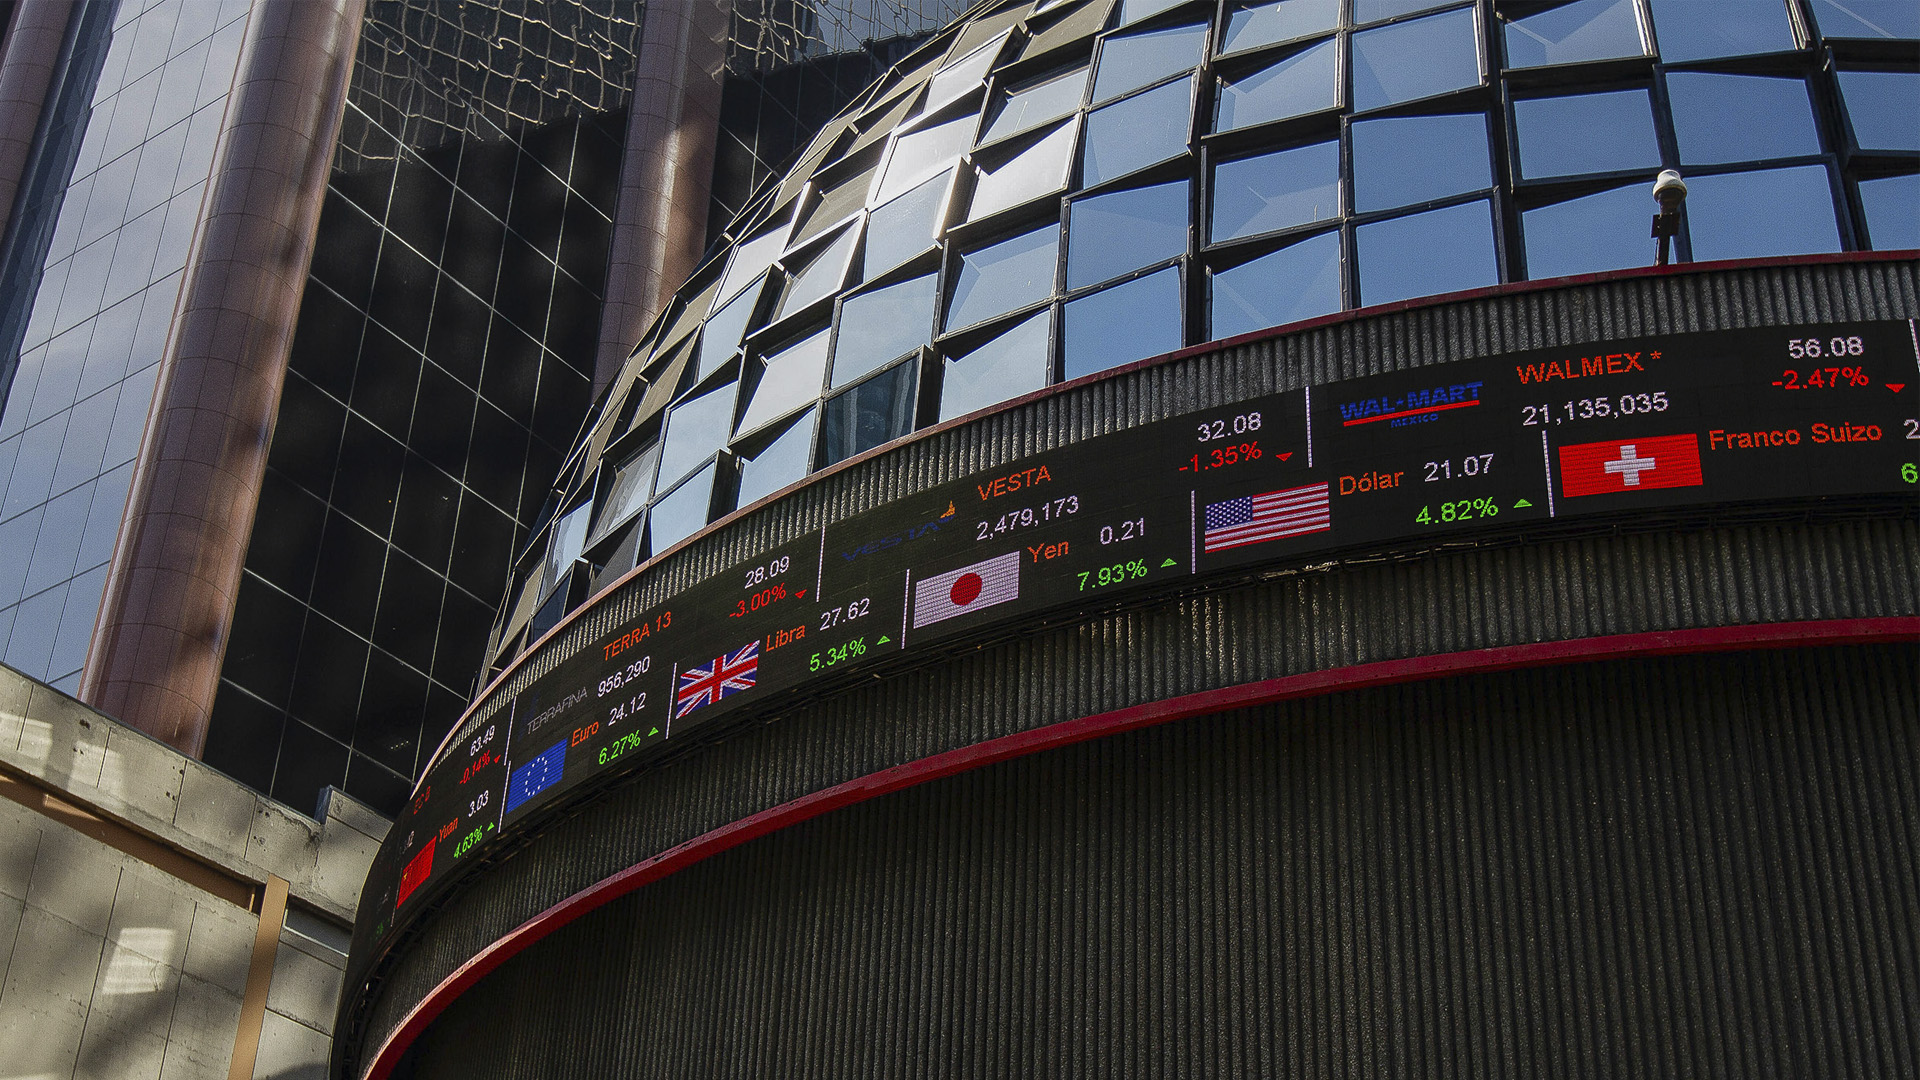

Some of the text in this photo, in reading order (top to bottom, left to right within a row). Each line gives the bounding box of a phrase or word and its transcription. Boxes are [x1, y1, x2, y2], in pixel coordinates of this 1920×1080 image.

[1788, 336, 1864, 359] 56.08
[1516, 352, 1645, 385] WALMEX
[1771, 366, 1870, 391] -2.47%
[1390, 413, 1439, 429] MEXICO
[1521, 392, 1669, 426] 21,135,035
[1197, 412, 1262, 443] 32.08
[1708, 421, 1883, 451] Franco Suizo
[1178, 441, 1263, 474] -1.35%
[1423, 454, 1495, 483] 21.07
[977, 465, 1052, 501] VESTA
[1339, 468, 1405, 497] Dólar
[976, 494, 1080, 541] 2,479,173
[1415, 496, 1499, 526] 4.82%
[1100, 516, 1146, 546] 0.21
[1026, 538, 1070, 564] Yen
[744, 556, 790, 590] 28.09
[1076, 558, 1148, 592] 7.93%
[728, 582, 787, 619] -3.00%
[819, 597, 871, 632] 27.62
[603, 611, 672, 662] TERRA 13
[765, 624, 806, 653] Libra
[809, 636, 867, 673] 5.34%
[597, 655, 651, 699] 956,290
[526, 687, 588, 735] TERRAFINA
[607, 692, 647, 727] 24.12
[470, 724, 496, 757] 63.49
[570, 721, 600, 748] Euro
[598, 729, 641, 765] 6.27%
[458, 749, 491, 786] -0.14%
[468, 789, 489, 818] 3.03
[438, 817, 459, 843] Yuan
[453, 824, 483, 859] 4.63%
